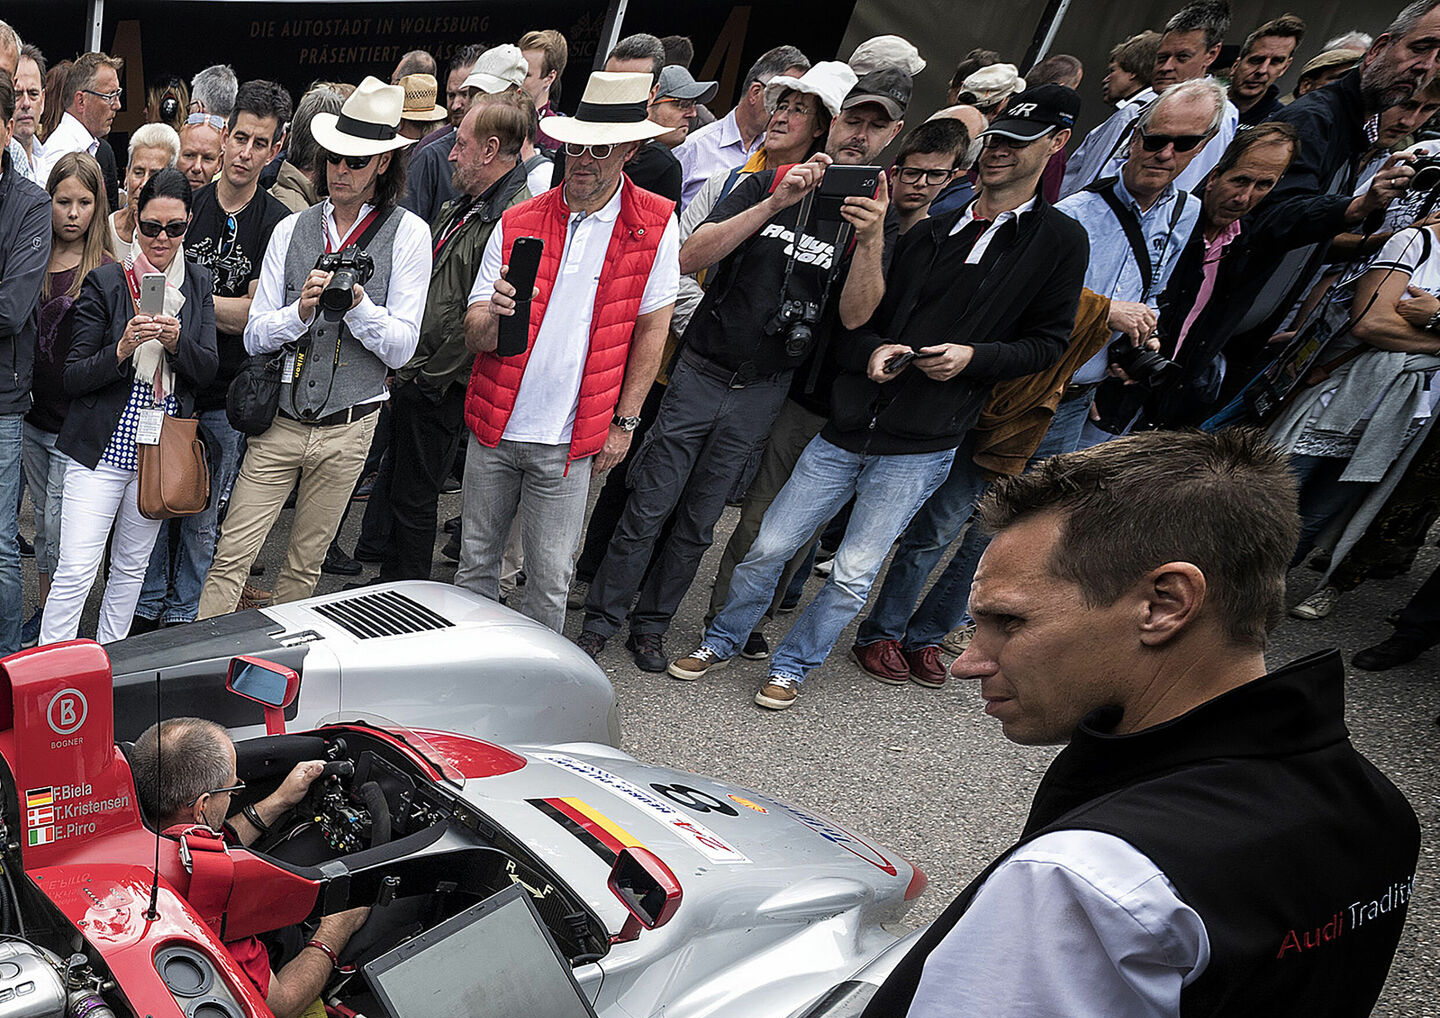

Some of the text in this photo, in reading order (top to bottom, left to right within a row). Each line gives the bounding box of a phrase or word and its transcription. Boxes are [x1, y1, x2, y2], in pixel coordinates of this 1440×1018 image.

[249, 16, 490, 38] DIE AUTOSTADT IN WOLFSBURG
[298, 43, 401, 65] PRÄSENTIERT
[295, 353, 305, 378] Nikon
[51, 737, 84, 749] BOGNER
[53, 781, 92, 801] F.Biela
[649, 783, 739, 817] 8
[54, 796, 129, 820] T.Kristensen
[55, 822, 96, 840] E.Pirro
[506, 860, 516, 874] R
[543, 884, 553, 895] F
[1277, 875, 1415, 959] Audi Traditi
